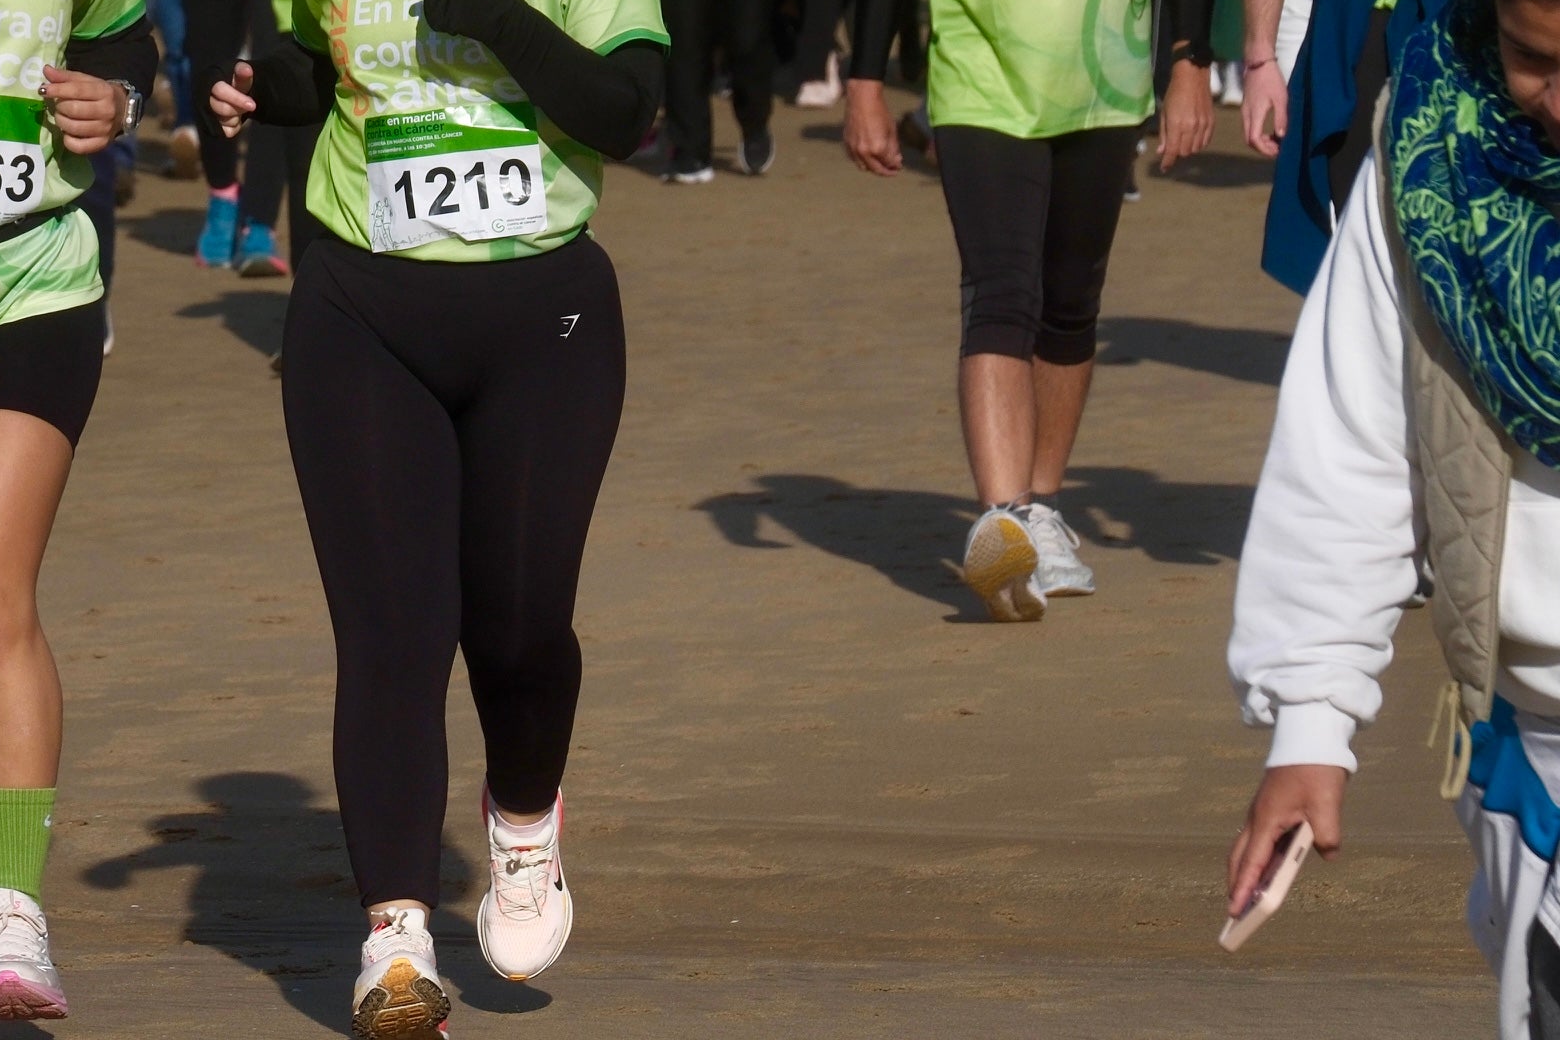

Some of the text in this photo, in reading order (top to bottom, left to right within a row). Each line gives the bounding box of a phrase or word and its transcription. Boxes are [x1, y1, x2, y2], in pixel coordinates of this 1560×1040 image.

[38, 7, 65, 46] el
[386, 116, 400, 127] en
[402, 110, 447, 125] marcha
[393, 126, 404, 136] el
[405, 122, 446, 135] cáncer
[412, 135, 434, 143] CONTRA
[394, 158, 533, 220] 1210
